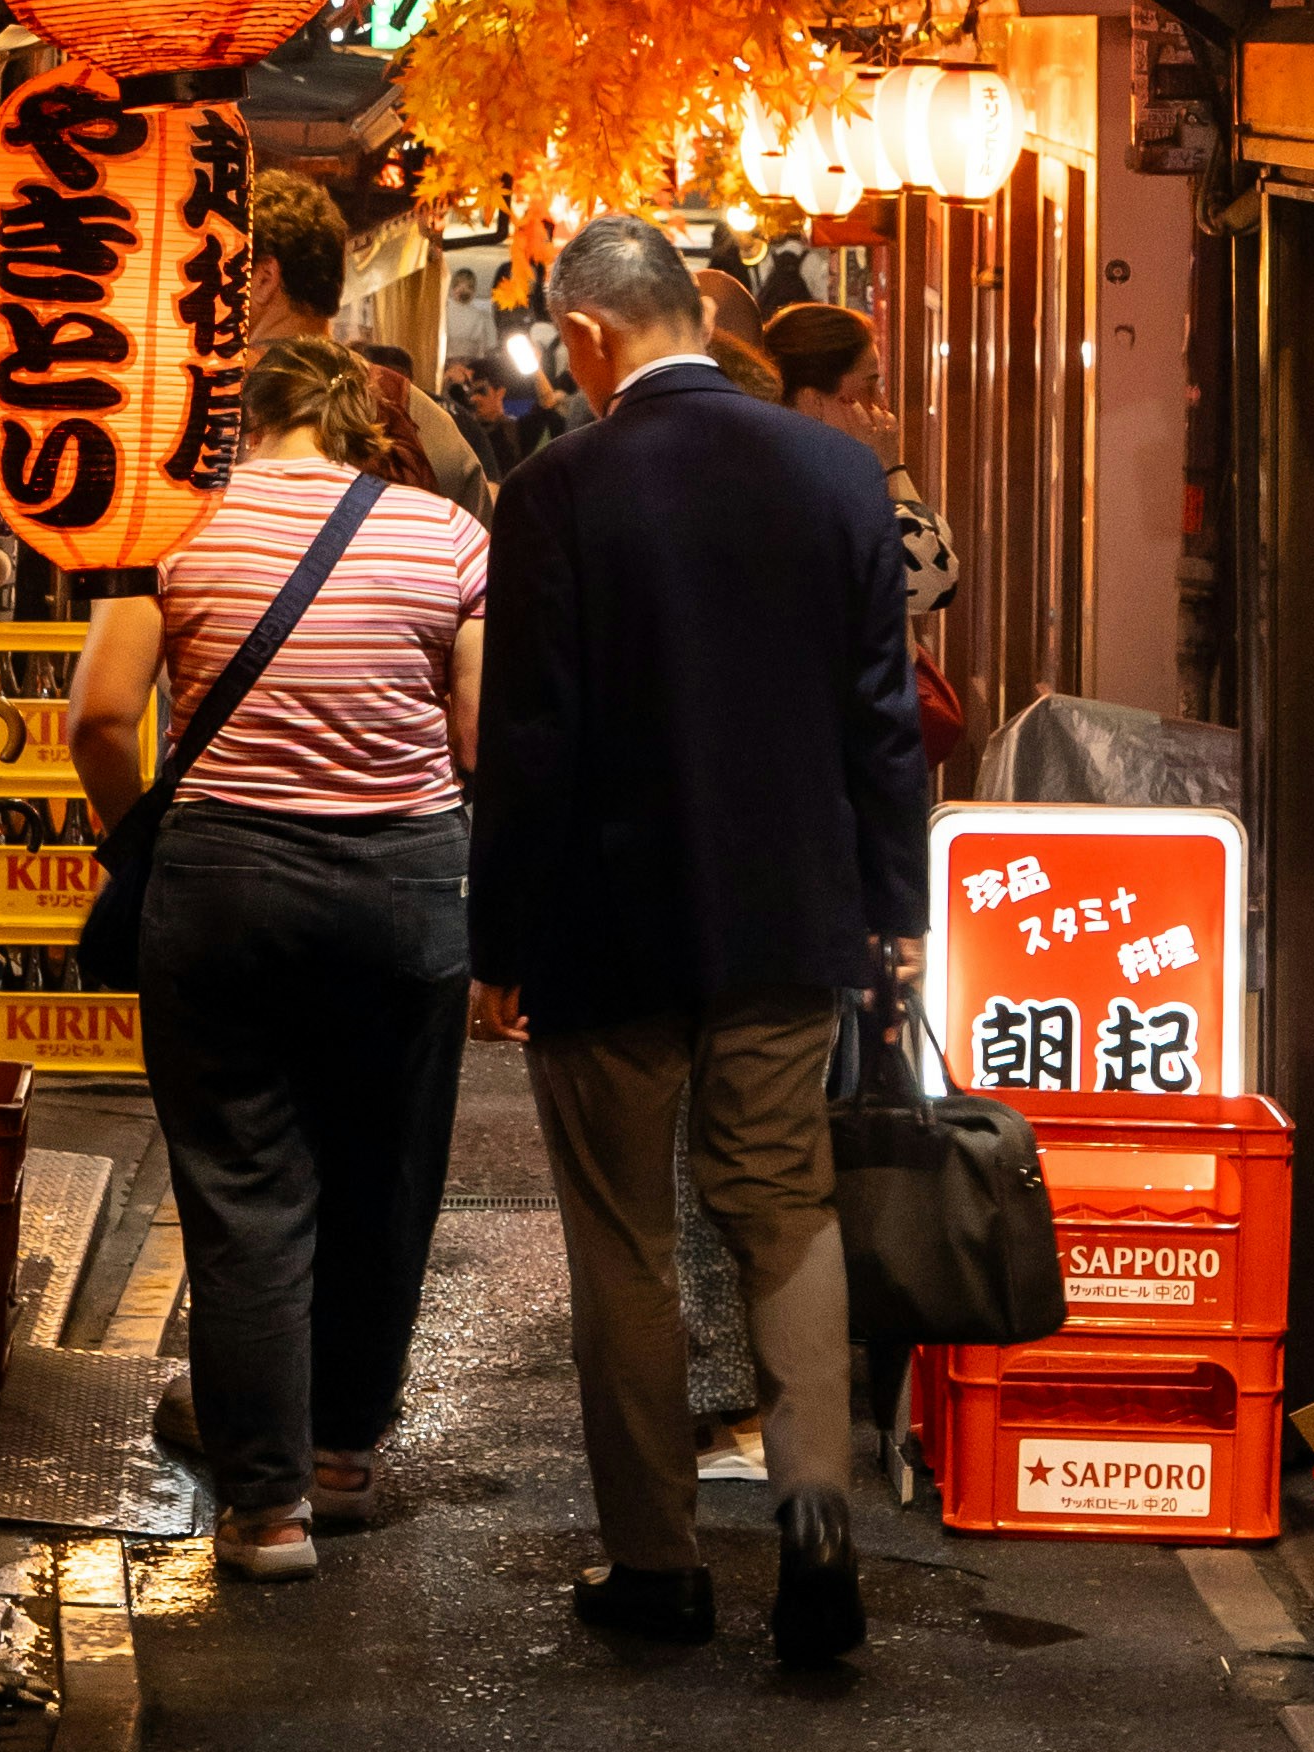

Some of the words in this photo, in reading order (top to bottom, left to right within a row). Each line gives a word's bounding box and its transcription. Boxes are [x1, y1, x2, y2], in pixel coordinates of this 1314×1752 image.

[7, 854, 100, 892] KIRI
[961, 855, 1052, 914] 珍品
[1018, 886, 1138, 956] スタミナ
[1117, 924, 1200, 985] 料理
[7, 1004, 135, 1041] KIRIN
[976, 999, 1196, 1093] 朝起
[1069, 1245, 1221, 1279] SAPPORO
[1069, 1283, 1151, 1299] サッポロビール
[1173, 1284, 1191, 1302] 20
[1061, 1460, 1206, 1491] SAPPORO
[1061, 1496, 1140, 1511] サッポロビール
[1160, 1496, 1178, 1513] 20
